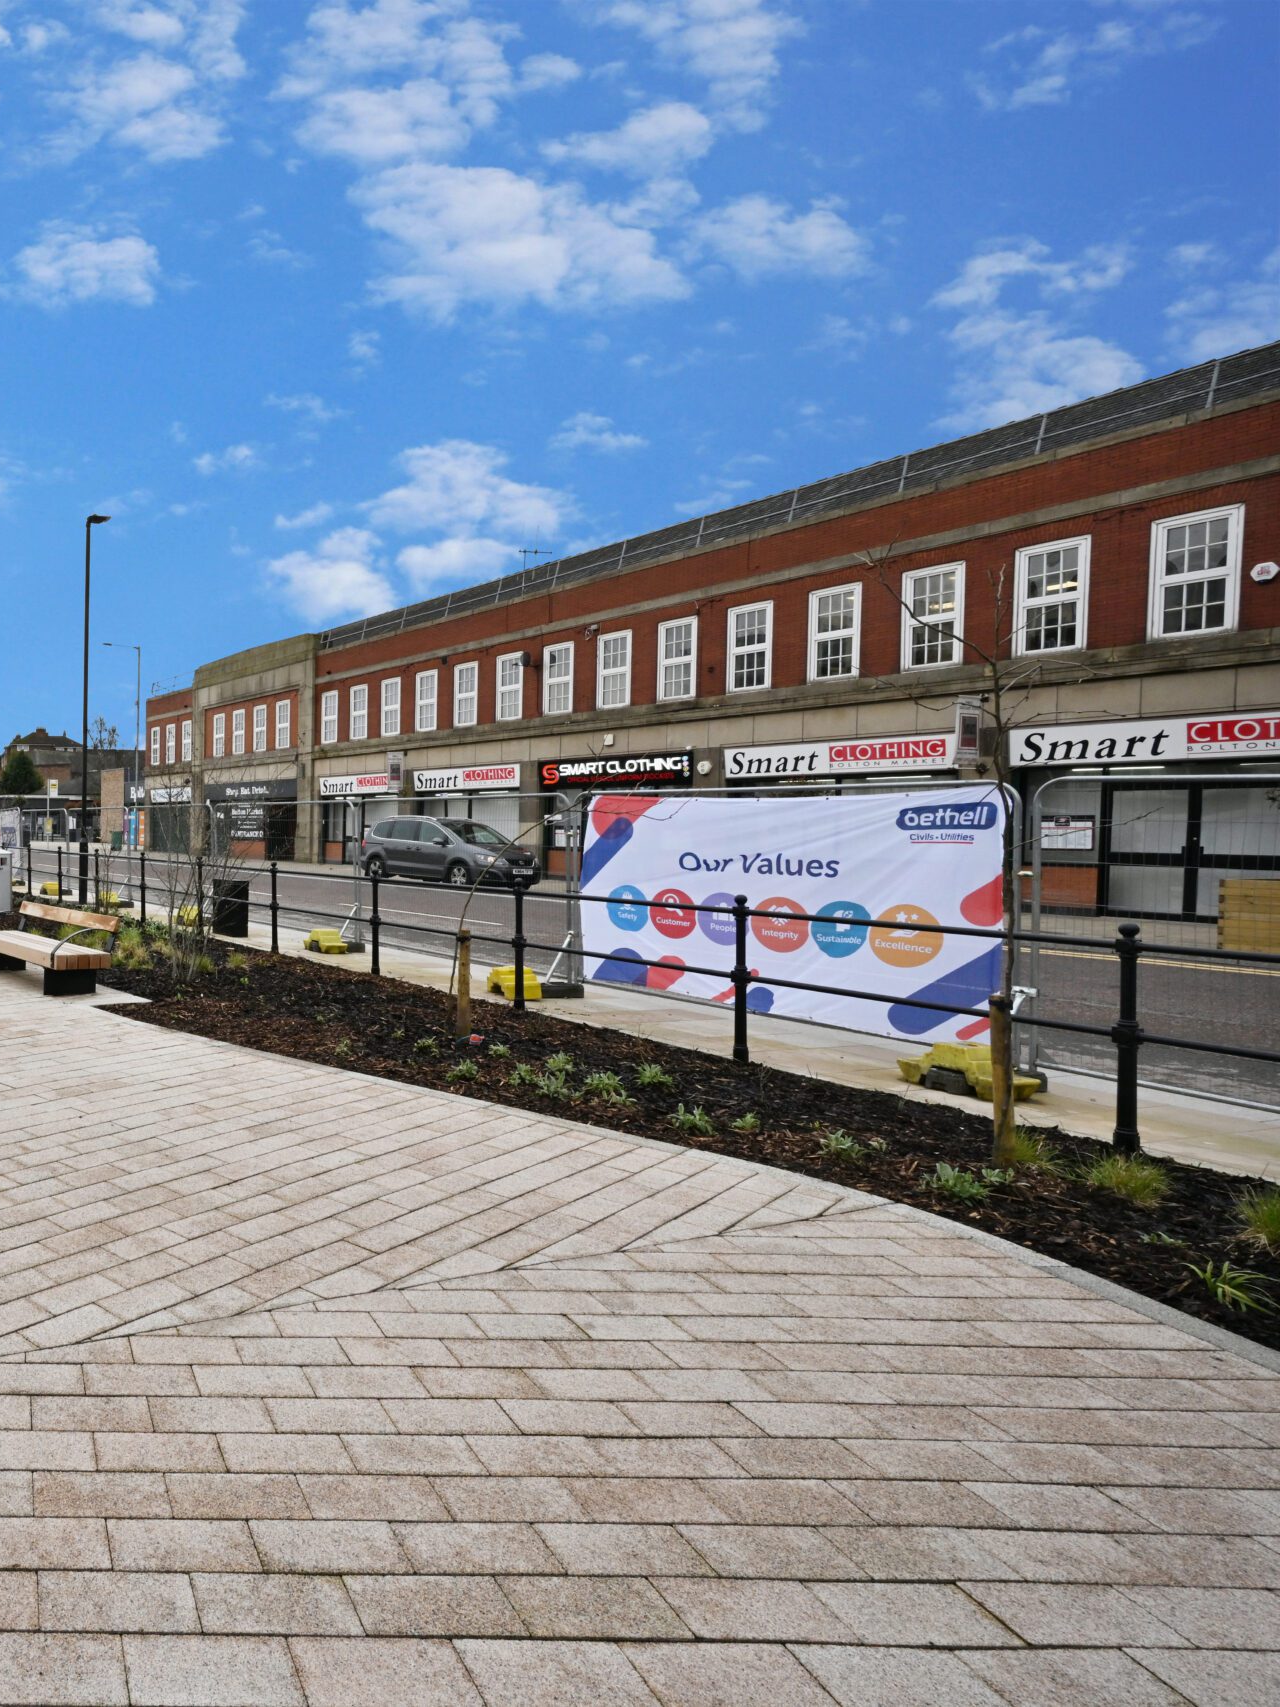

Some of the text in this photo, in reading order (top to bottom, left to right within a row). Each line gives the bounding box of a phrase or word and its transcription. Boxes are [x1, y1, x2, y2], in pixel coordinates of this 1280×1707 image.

[1020, 719, 1280, 763] Smart CLOT
[1186, 741, 1276, 752] BOLTON
[729, 740, 945, 775] Smart CLOTHING
[829, 758, 945, 769] BOLTON MARKET
[559, 761, 606, 777] SMART
[606, 756, 682, 774] CLOTHING
[416, 768, 515, 789] Smart CLOTHING
[322, 779, 354, 794] Smart
[904, 806, 988, 827] bethell
[909, 833, 974, 841] Civils Utilities
[678, 851, 840, 878] Our Values
[617, 911, 638, 922] Safety
[655, 916, 691, 928] Customer
[710, 922, 737, 933] People
[761, 928, 800, 941] Integrity
[874, 938, 933, 954] Excellence
